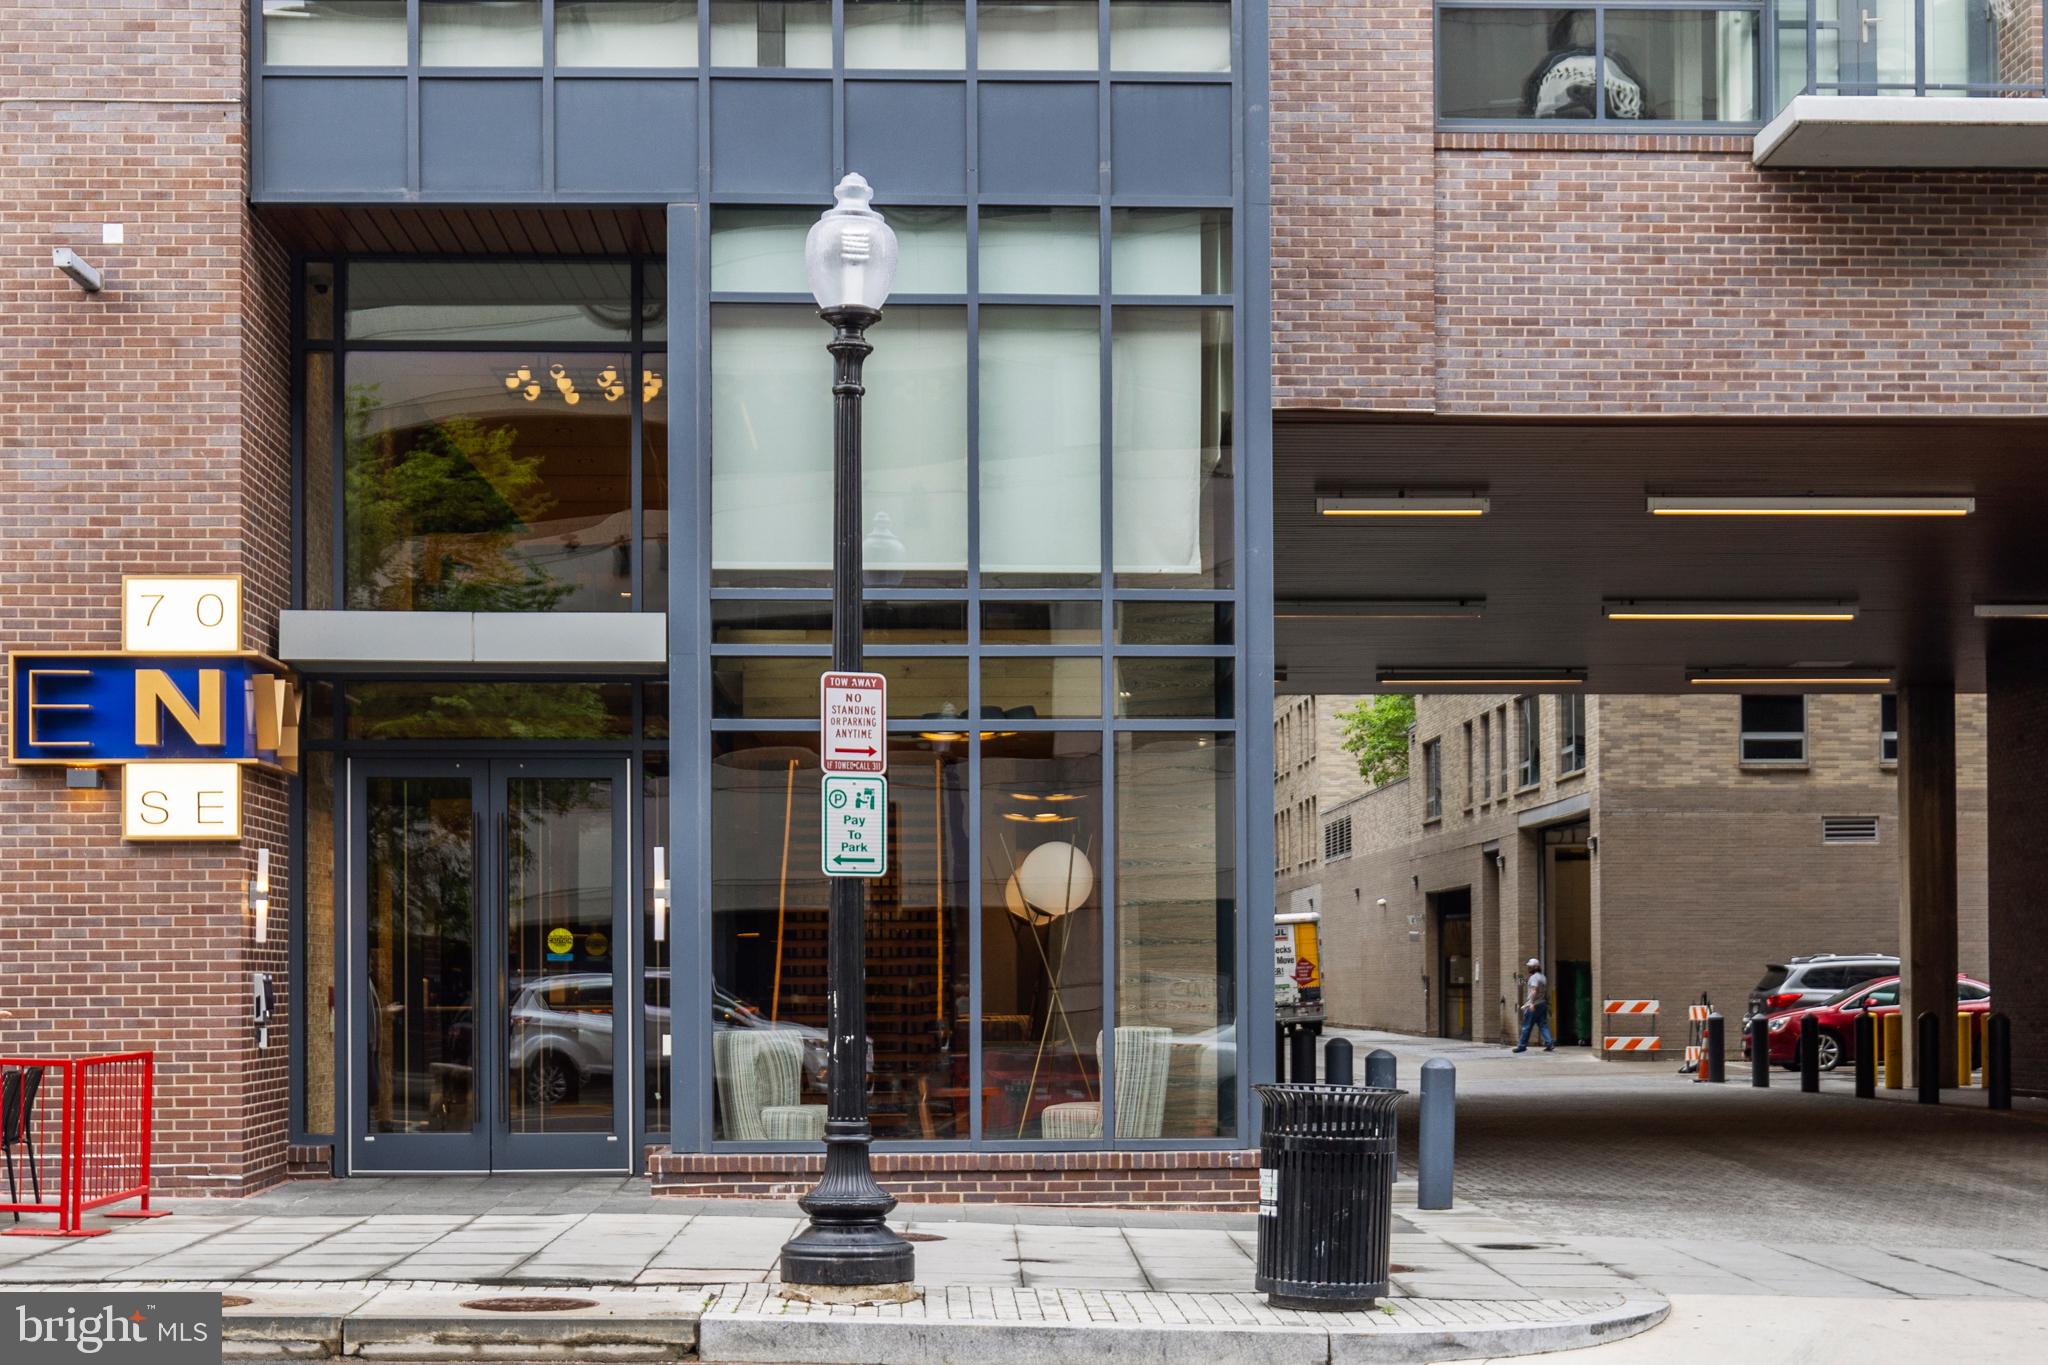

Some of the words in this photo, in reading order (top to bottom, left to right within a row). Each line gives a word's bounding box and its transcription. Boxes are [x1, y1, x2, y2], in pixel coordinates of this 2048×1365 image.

[140, 593, 224, 627] 70
[830, 677, 849, 687] TOW
[851, 678, 877, 687] AWAY
[845, 693, 862, 703] NO
[831, 704, 876, 716] STANDING
[830, 717, 841, 725] OR
[842, 717, 877, 727] PARKING
[835, 729, 872, 739] ANYTIME
[826, 761, 832, 769] IF
[140, 791, 224, 825] SE
[843, 815, 866, 827] Pay
[848, 830, 862, 840] To
[841, 842, 868, 852] Park
[1275, 945, 1292, 953] ecks
